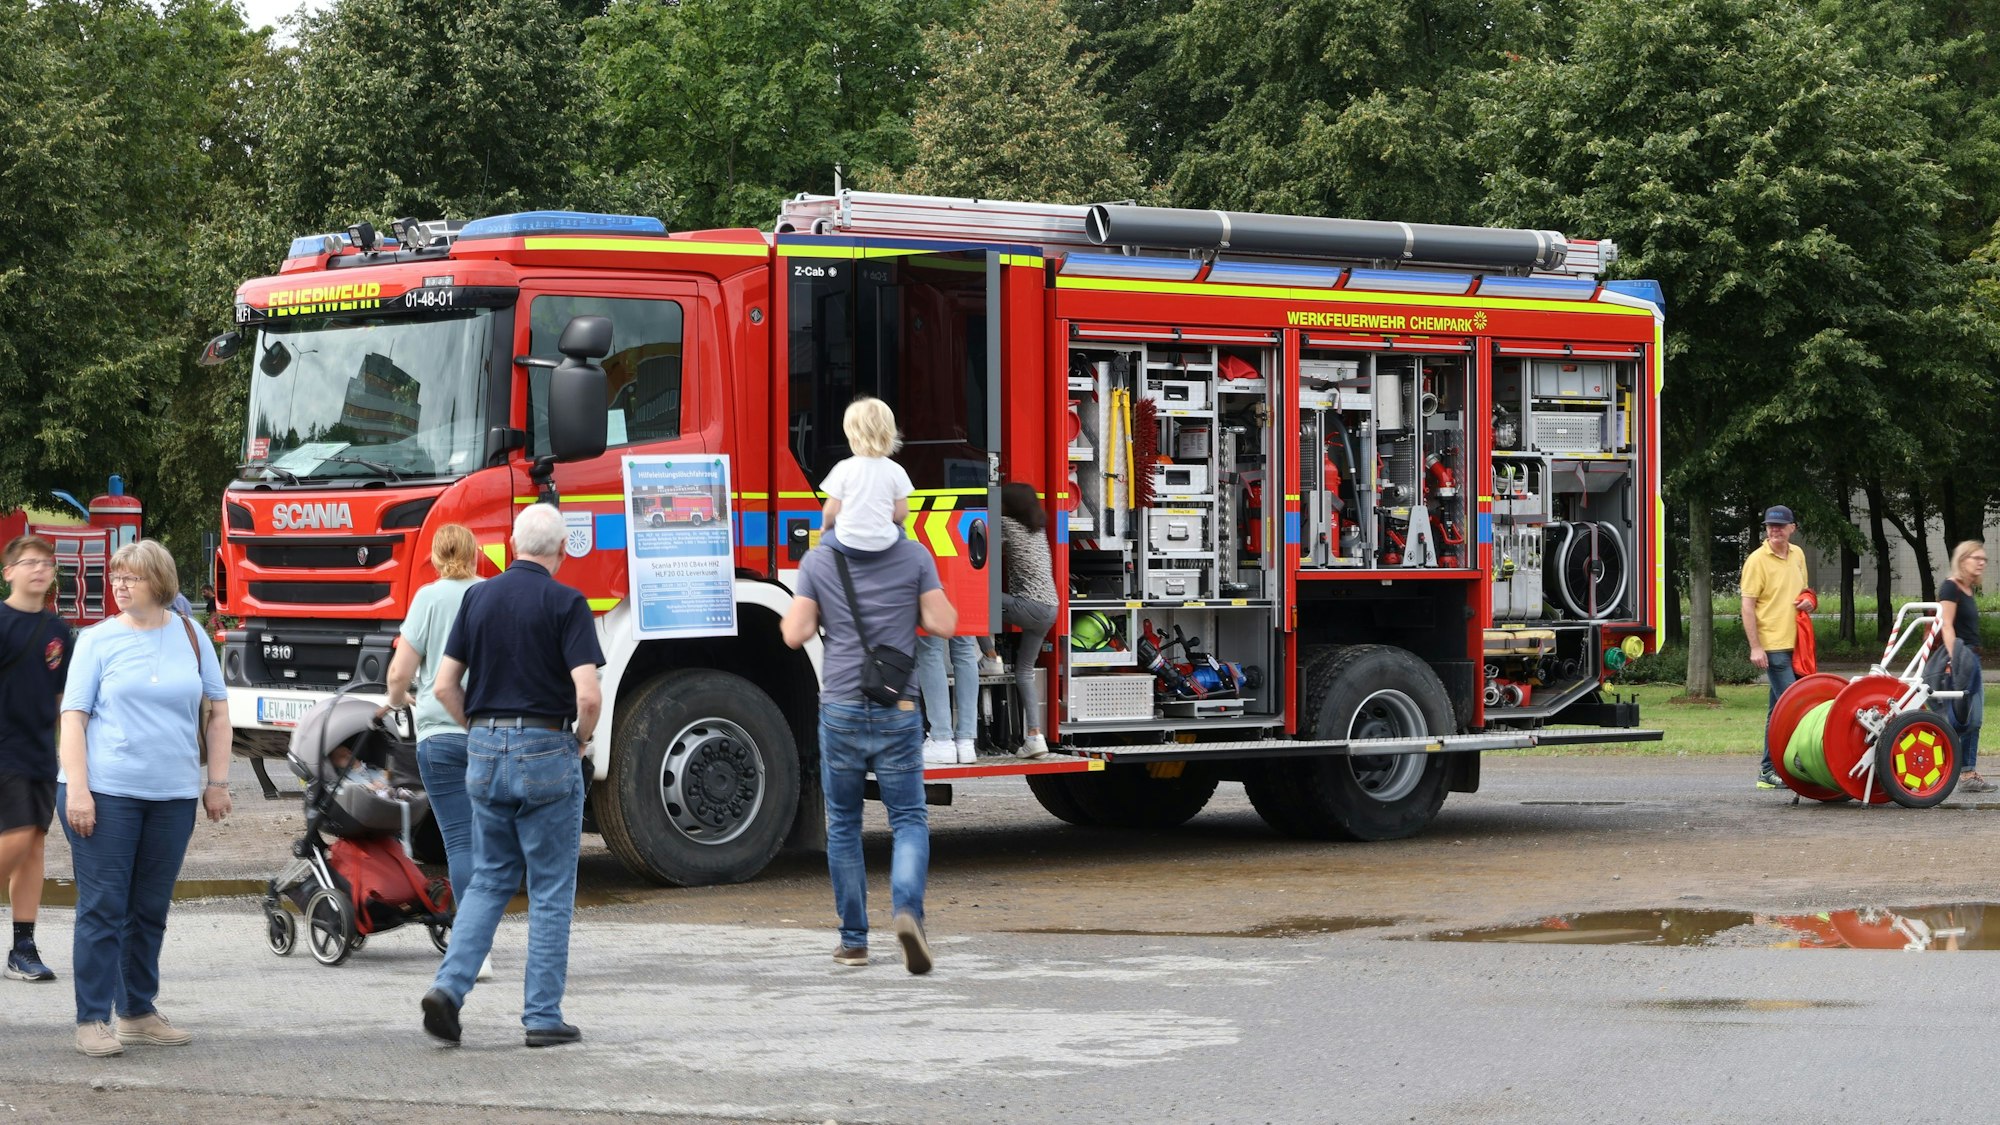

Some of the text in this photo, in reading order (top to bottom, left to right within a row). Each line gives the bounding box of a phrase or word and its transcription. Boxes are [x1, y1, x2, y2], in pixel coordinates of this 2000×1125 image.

[794, 266, 825, 277] Z-Cab
[267, 282, 381, 318] FEUERWEHR
[405, 290, 453, 308] 01-48-01
[1287, 311, 1473, 332] WERKFEUERWEHR CHEMPARK
[272, 501, 353, 530] SCANIA
[263, 701, 280, 719] LEV
[285, 702, 296, 720] AU
